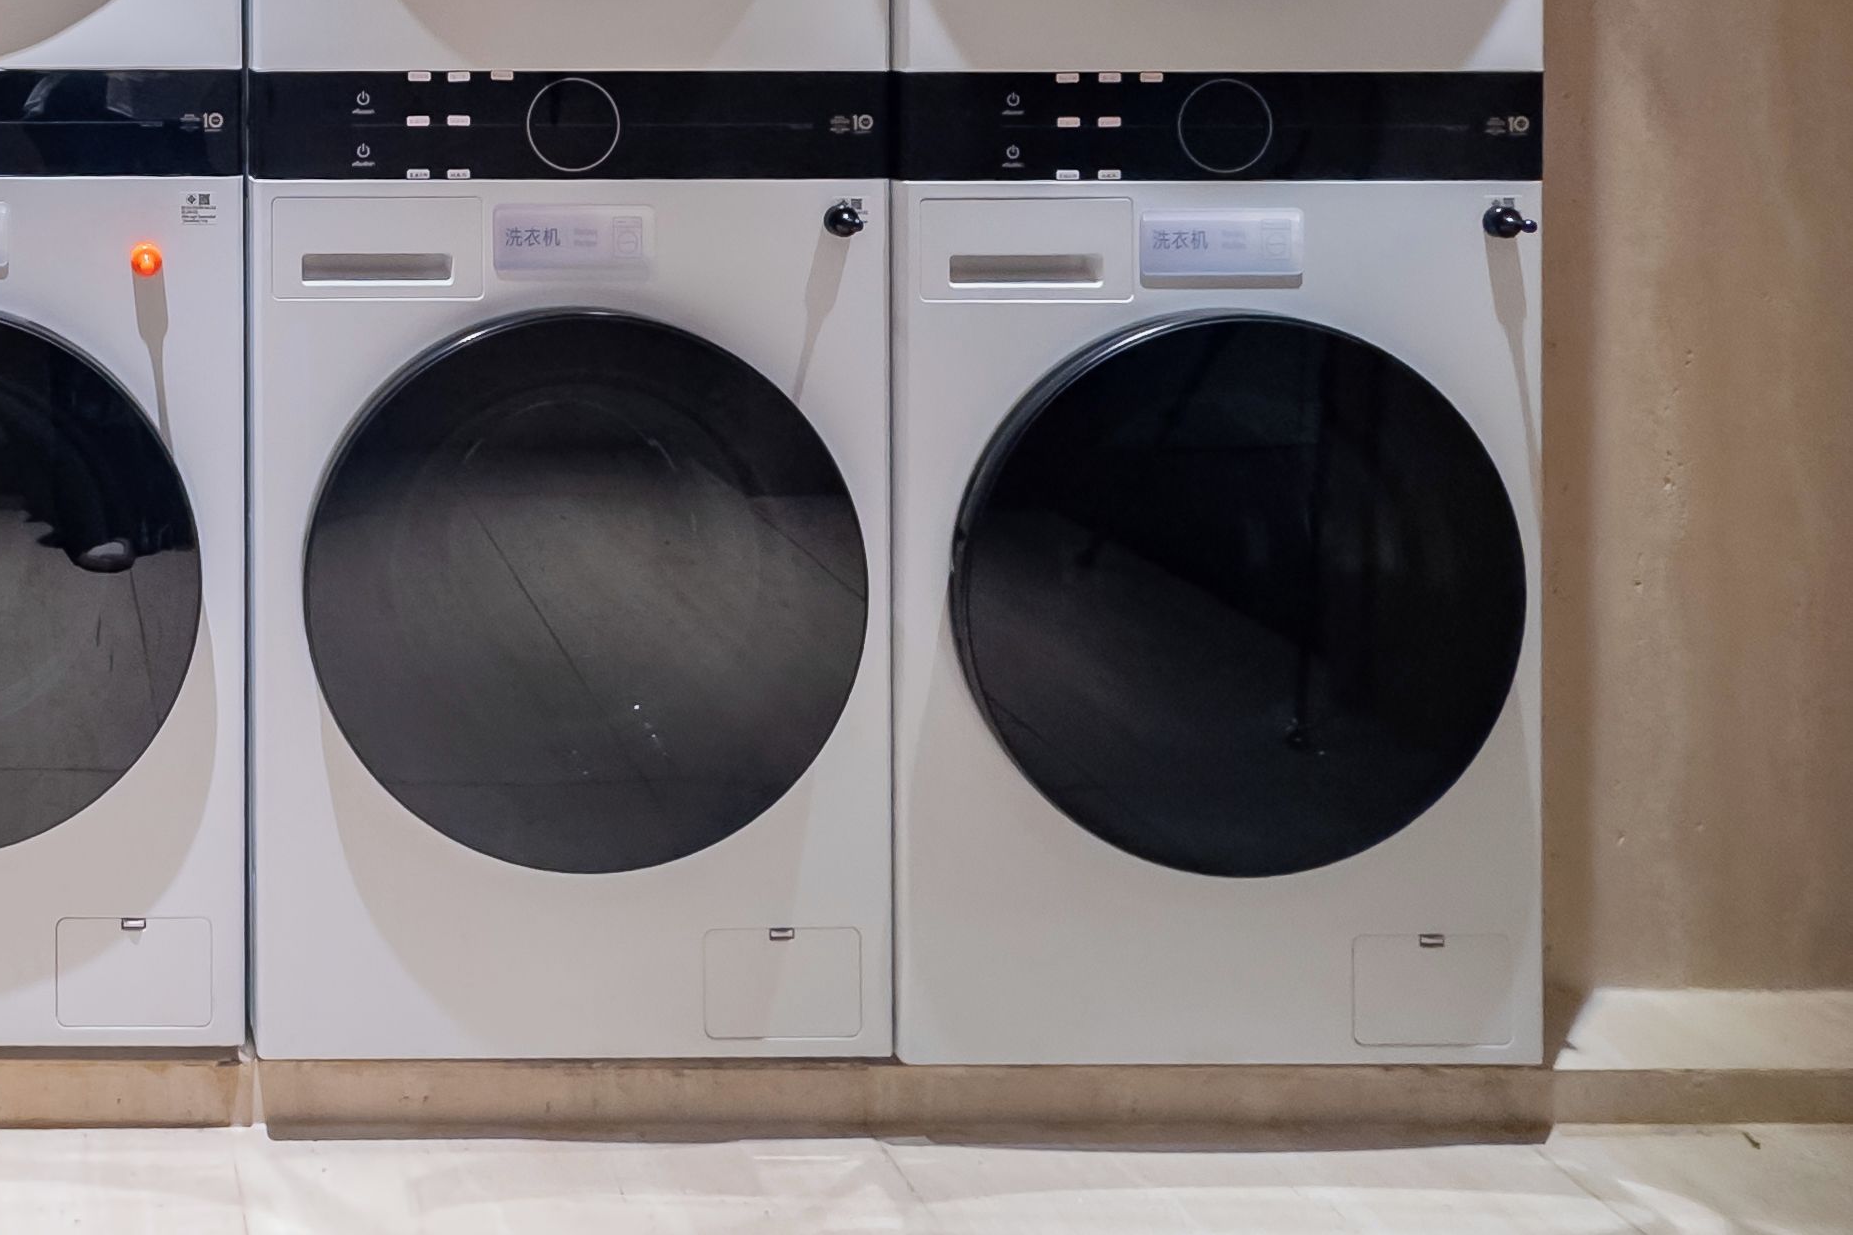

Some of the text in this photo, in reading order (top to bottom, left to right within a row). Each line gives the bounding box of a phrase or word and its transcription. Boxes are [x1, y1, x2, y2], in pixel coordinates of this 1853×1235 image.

[504, 227, 561, 248] 洗衣机
[1152, 229, 1209, 251] 洗衣机
